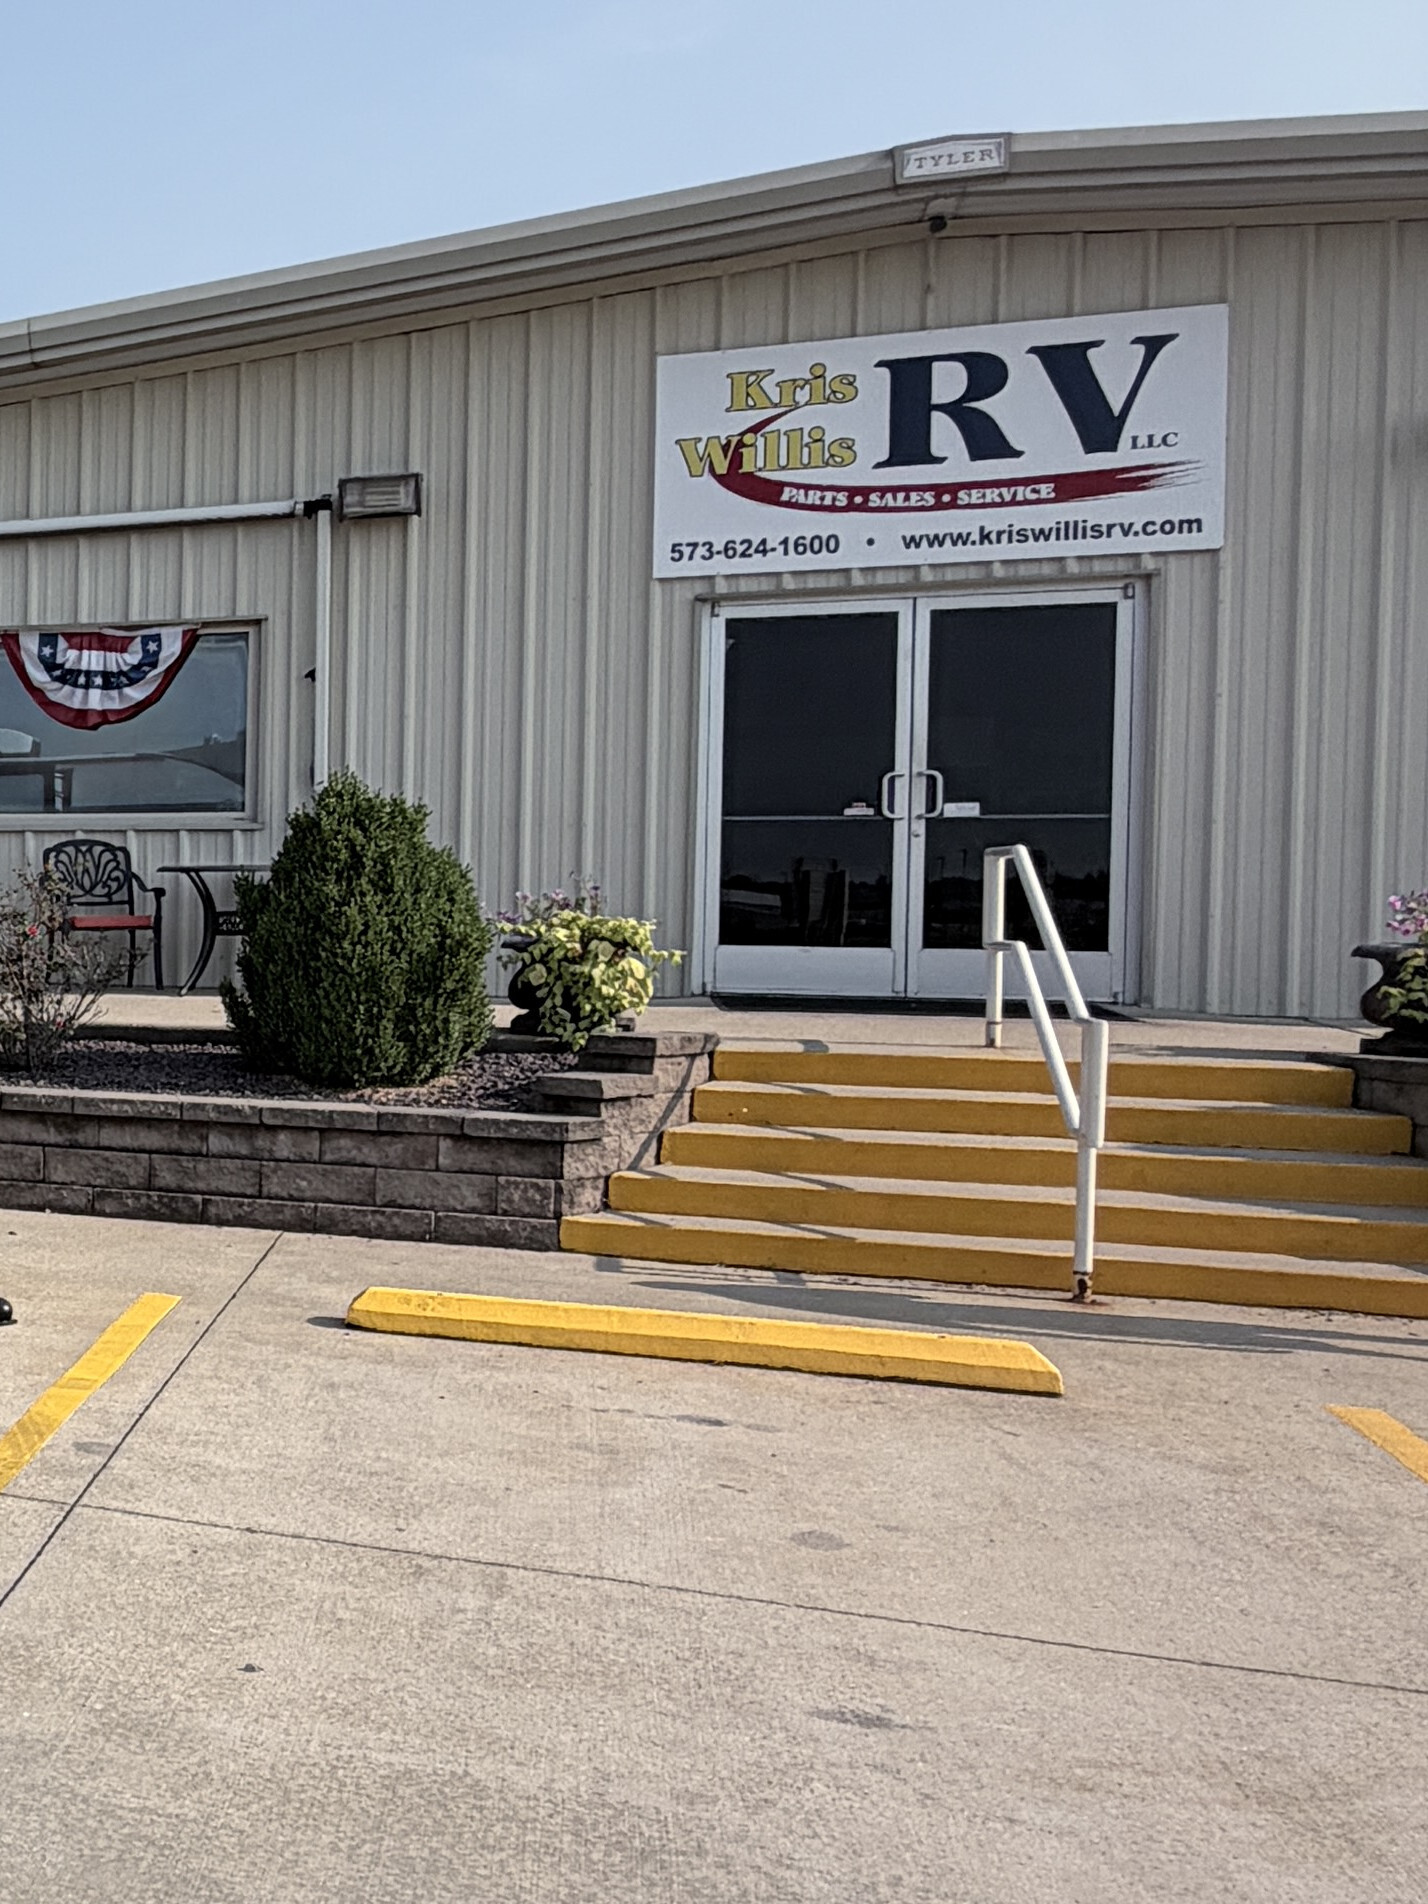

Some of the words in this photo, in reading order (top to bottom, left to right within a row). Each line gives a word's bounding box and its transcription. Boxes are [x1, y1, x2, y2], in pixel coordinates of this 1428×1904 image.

[913, 148, 995, 169] TYLER
[725, 362, 859, 413] Kris
[872, 333, 1180, 470] RV
[675, 425, 859, 478] Willis
[1130, 431, 1179, 450] LLC
[779, 486, 849, 508] PARTS
[867, 490, 936, 508] SALES
[956, 482, 1056, 506] SERVICE
[669, 532, 841, 563] 573-624-1600
[901, 514, 1204, 552] www.kriswillisrv.com
